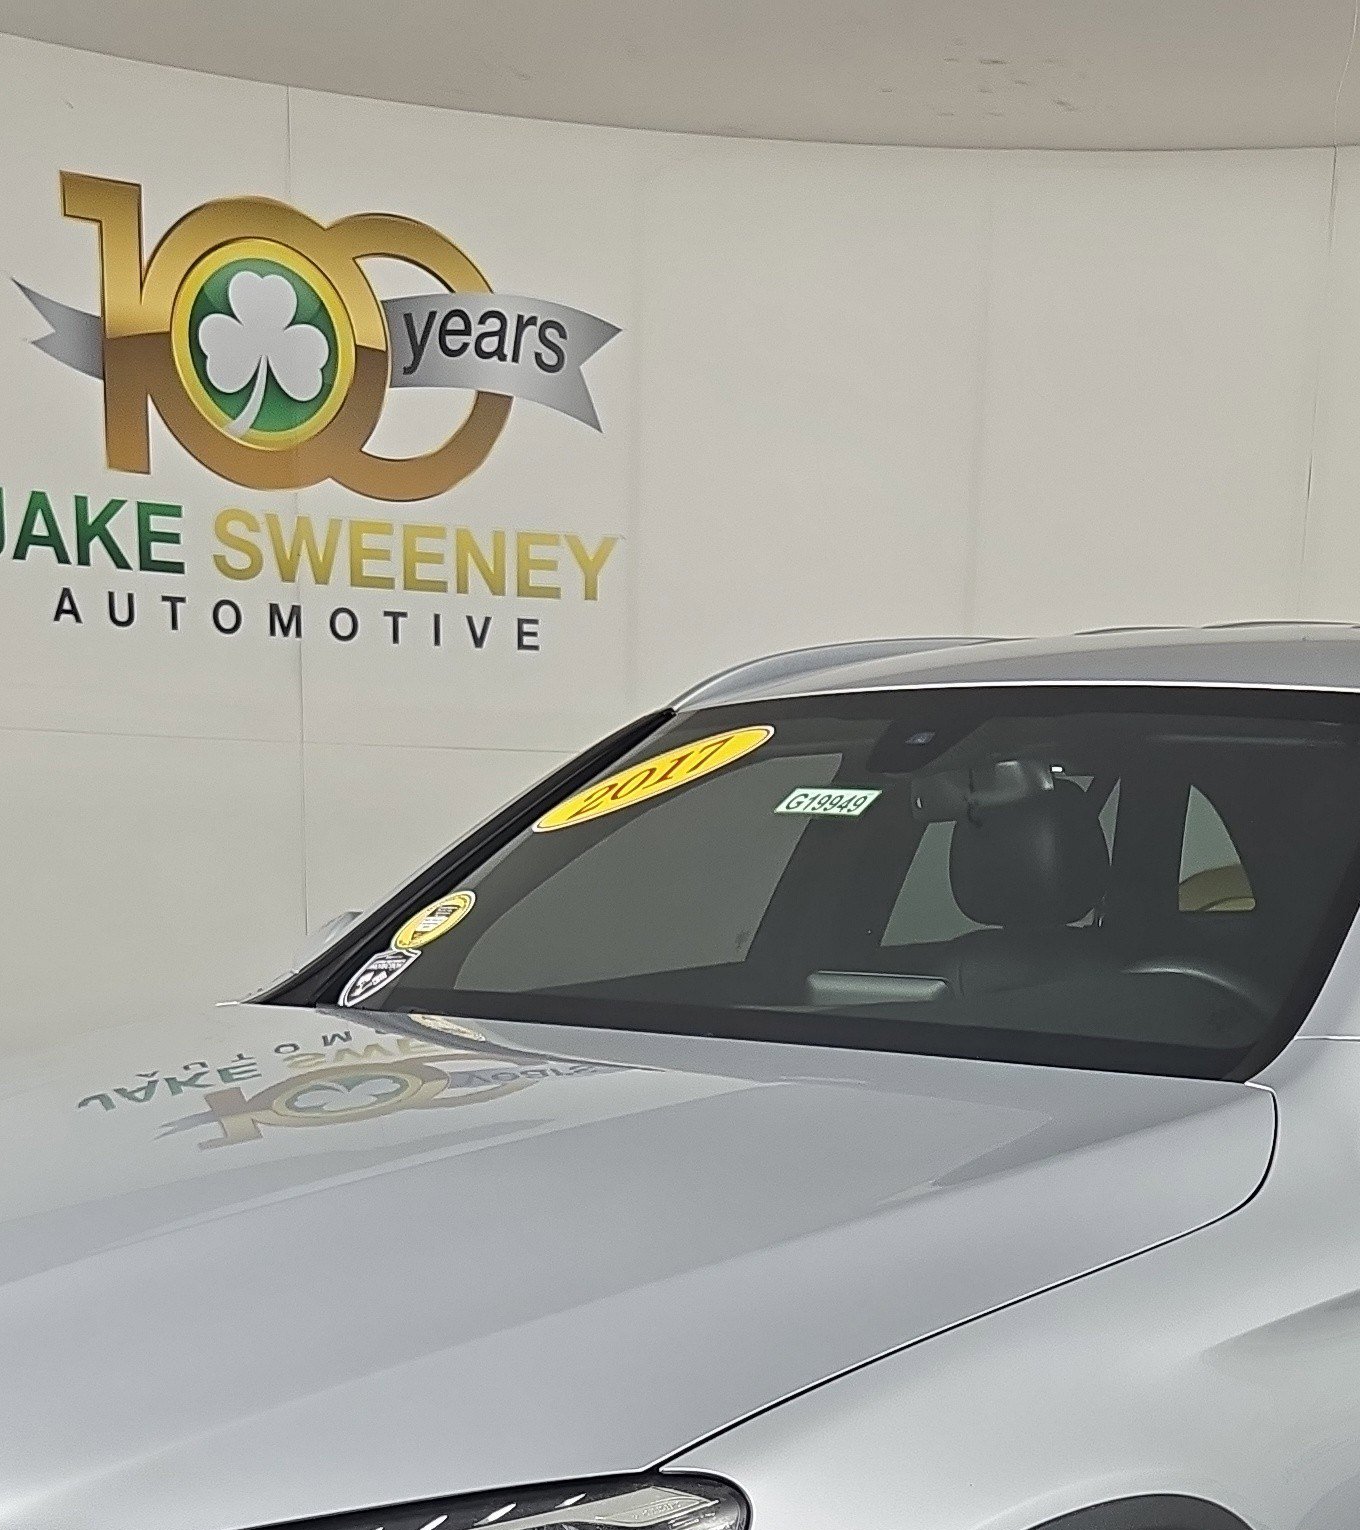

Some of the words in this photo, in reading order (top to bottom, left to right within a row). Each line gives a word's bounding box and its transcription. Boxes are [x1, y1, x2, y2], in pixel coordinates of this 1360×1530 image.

[59, 171, 514, 503] 100
[402, 307, 568, 376] years
[213, 508, 620, 601] SWEENEY
[53, 588, 540, 652] AUTOMOTIVE
[566, 735, 735, 821] 2017
[785, 792, 869, 814] G19949
